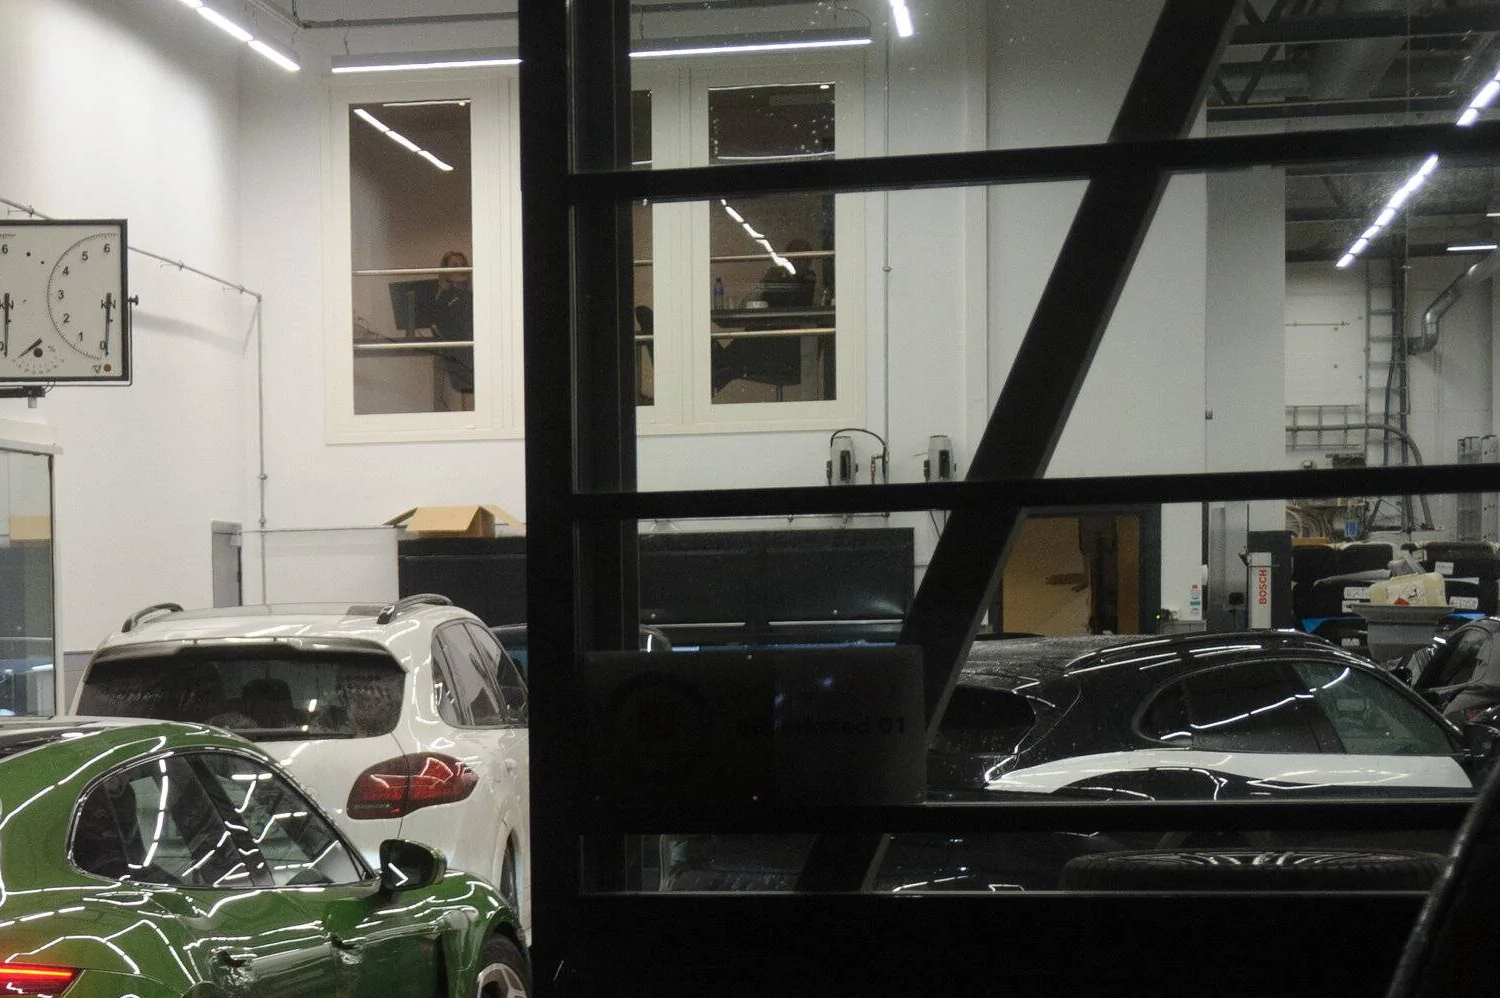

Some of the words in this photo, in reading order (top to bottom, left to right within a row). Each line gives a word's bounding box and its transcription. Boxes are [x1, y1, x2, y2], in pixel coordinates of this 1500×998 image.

[1, 244, 9, 255] 6
[103, 243, 111, 254] 6
[81, 251, 89, 262] 5
[62, 265, 70, 276] 4
[57, 290, 65, 301] 3
[62, 313, 71, 324] 2
[77, 331, 84, 342] 1
[99, 340, 106, 351] 0
[1258, 569, 1268, 605] BOSCH
